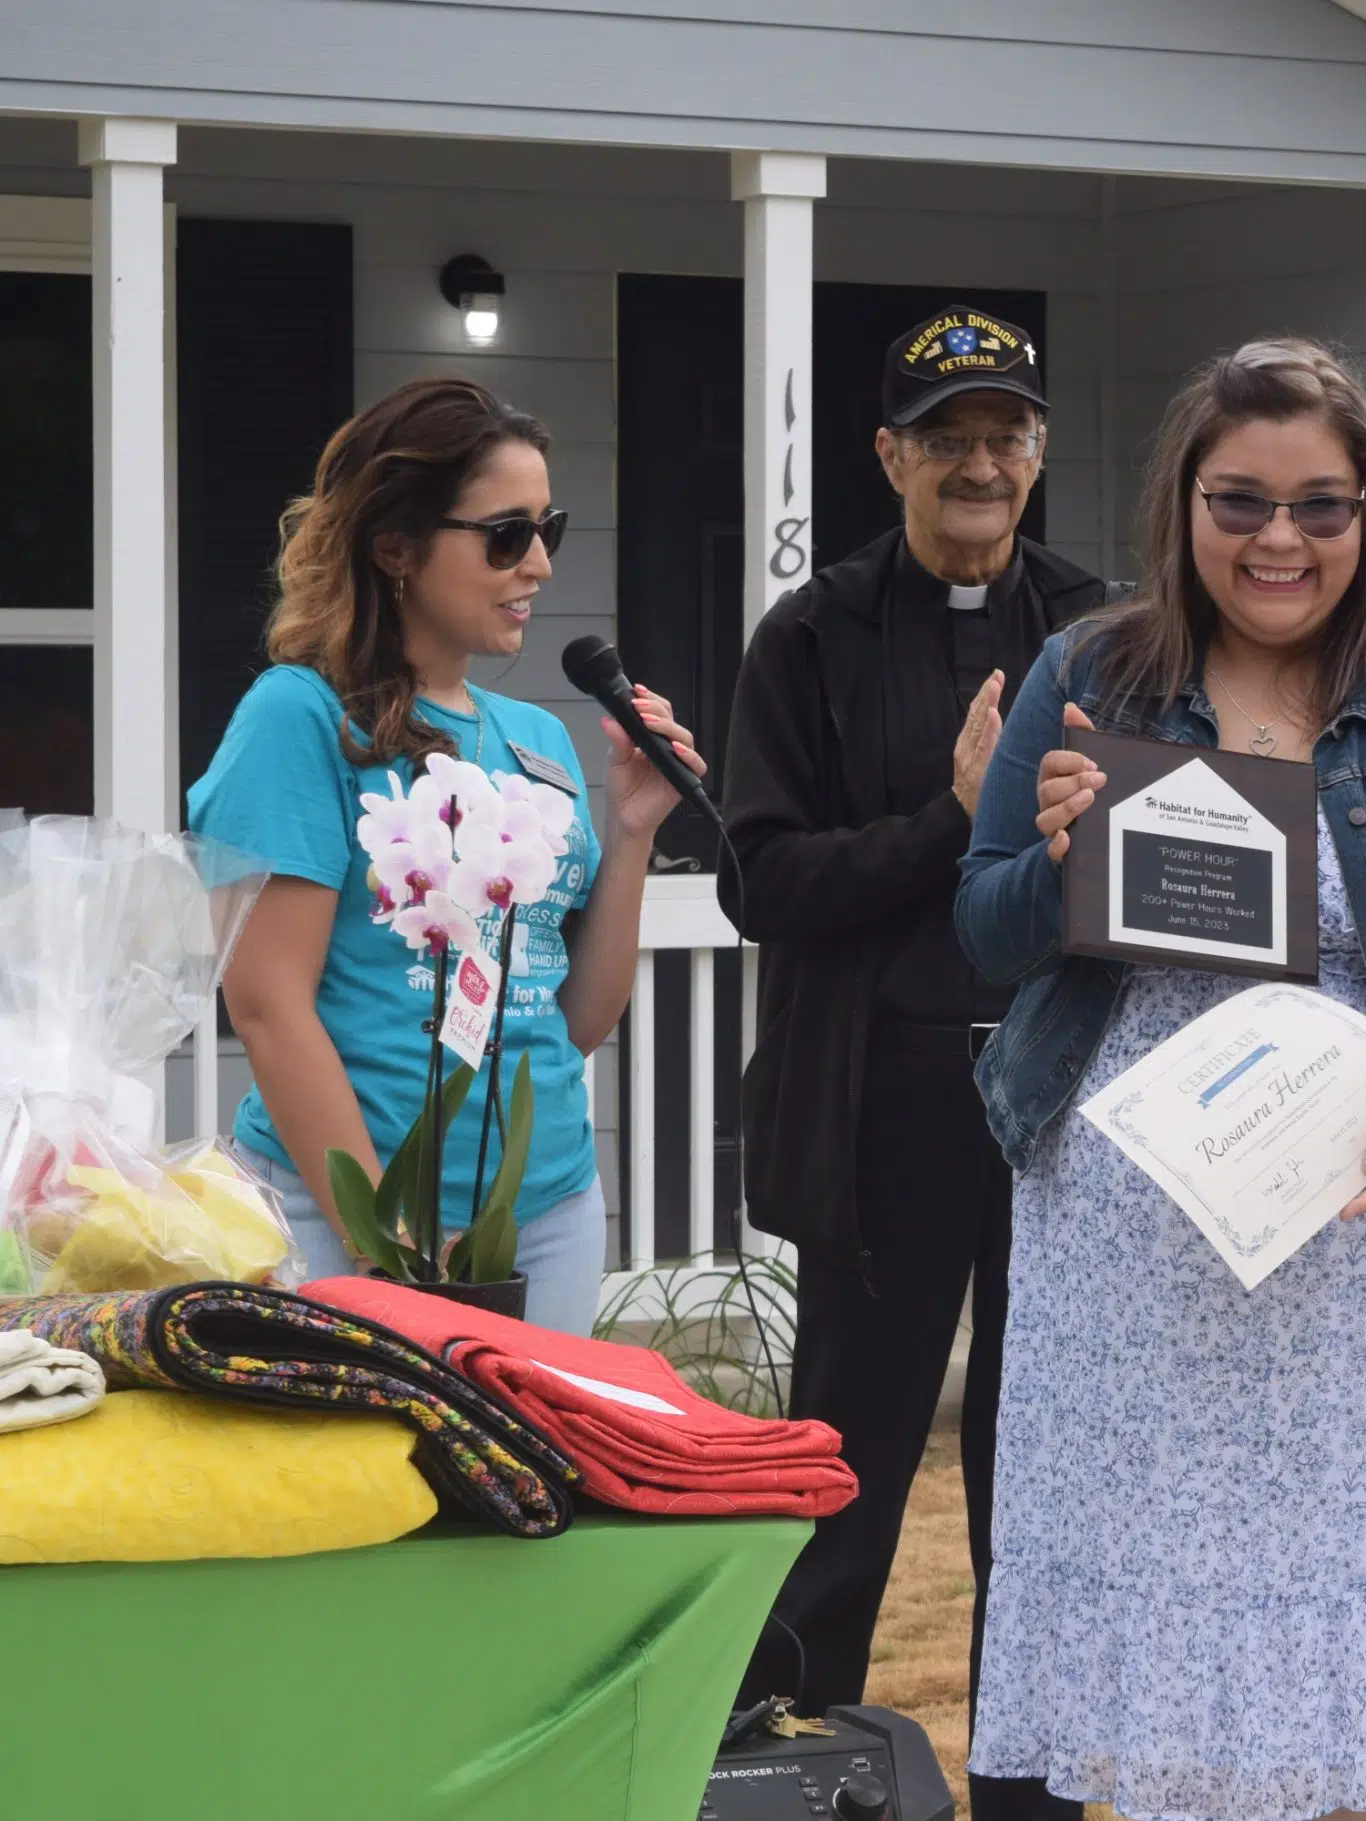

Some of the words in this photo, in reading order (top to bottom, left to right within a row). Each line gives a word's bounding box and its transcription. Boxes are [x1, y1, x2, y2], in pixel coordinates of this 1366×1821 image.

[904, 314, 963, 364] AMERICAL
[967, 314, 1019, 349] DIVISION
[937, 355, 996, 373] VETERAN
[769, 367, 810, 603] 118
[1159, 801, 1191, 815] Habitat
[1193, 807, 1206, 818] for
[1166, 813, 1176, 821] San
[1177, 815, 1199, 825] Antonio
[1205, 820, 1233, 831] Guadalupe
[1233, 824, 1249, 833] Valley
[1204, 870, 1233, 881] Program
[1161, 878, 1197, 895] Rosaura
[1200, 884, 1236, 900] Herrera
[1142, 894, 1167, 905] 200+
[1170, 898, 1195, 910] Power
[1198, 903, 1222, 914] Hours
[1225, 906, 1255, 919] Worked
[1167, 914, 1186, 925] June
[1204, 919, 1230, 931] 2023
[512, 984, 535, 1003] for
[524, 1006, 535, 1016] &
[1178, 1028, 1263, 1095] CERTIFICATE
[1195, 1102, 1272, 1165] Rosaura
[1268, 1045, 1342, 1107] Herrera
[707, 1770, 730, 1780] OCK
[731, 1767, 773, 1779] ROCKER
[775, 1764, 802, 1775] PLUS
